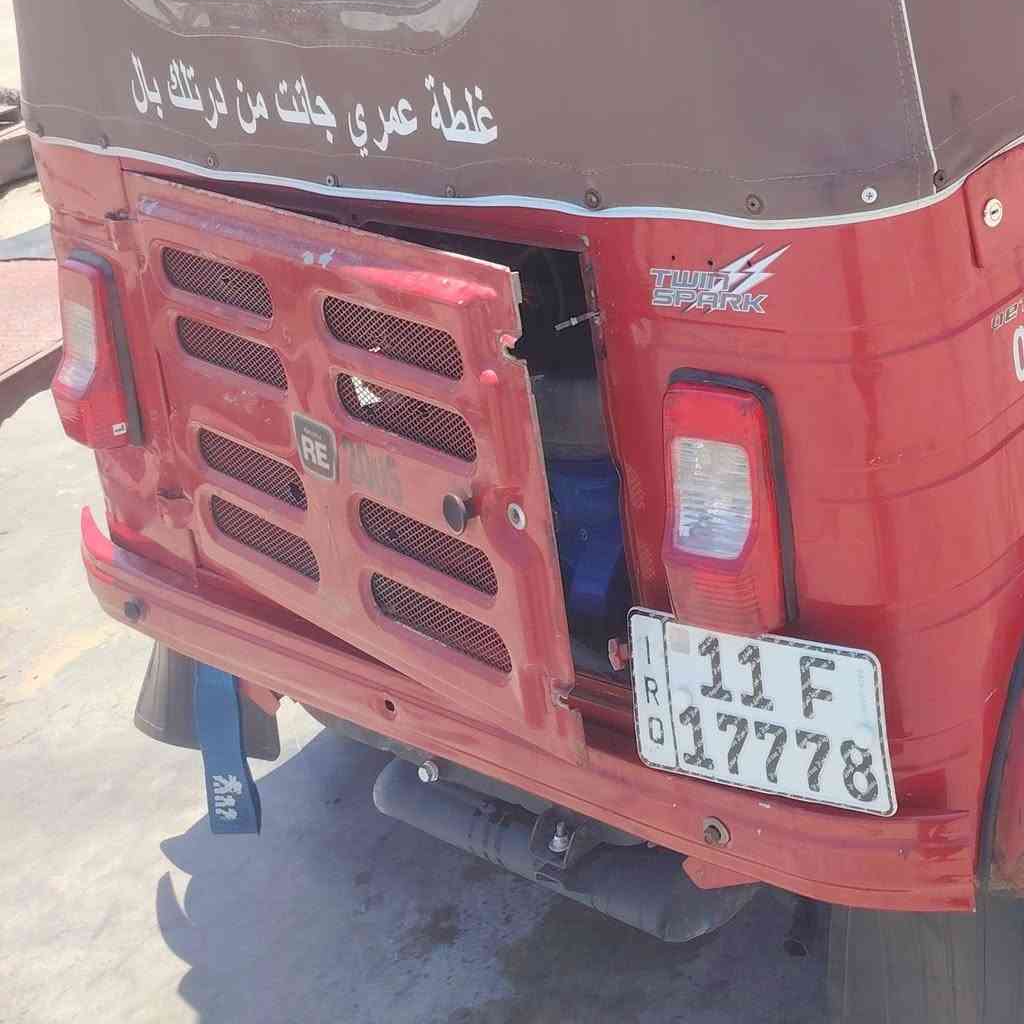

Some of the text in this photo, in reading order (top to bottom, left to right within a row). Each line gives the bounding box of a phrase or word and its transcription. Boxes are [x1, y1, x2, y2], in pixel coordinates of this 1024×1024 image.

[236, 79, 268, 134] من
[348, 98, 418, 158] عمري
[424, 74, 498, 144] غلطة
[650, 267, 730, 292] TWIN
[651, 287, 768, 314] SPARK
[301, 435, 331, 471] RE
[698, 635, 836, 720] 11 F
[679, 705, 879, 802] 17778
